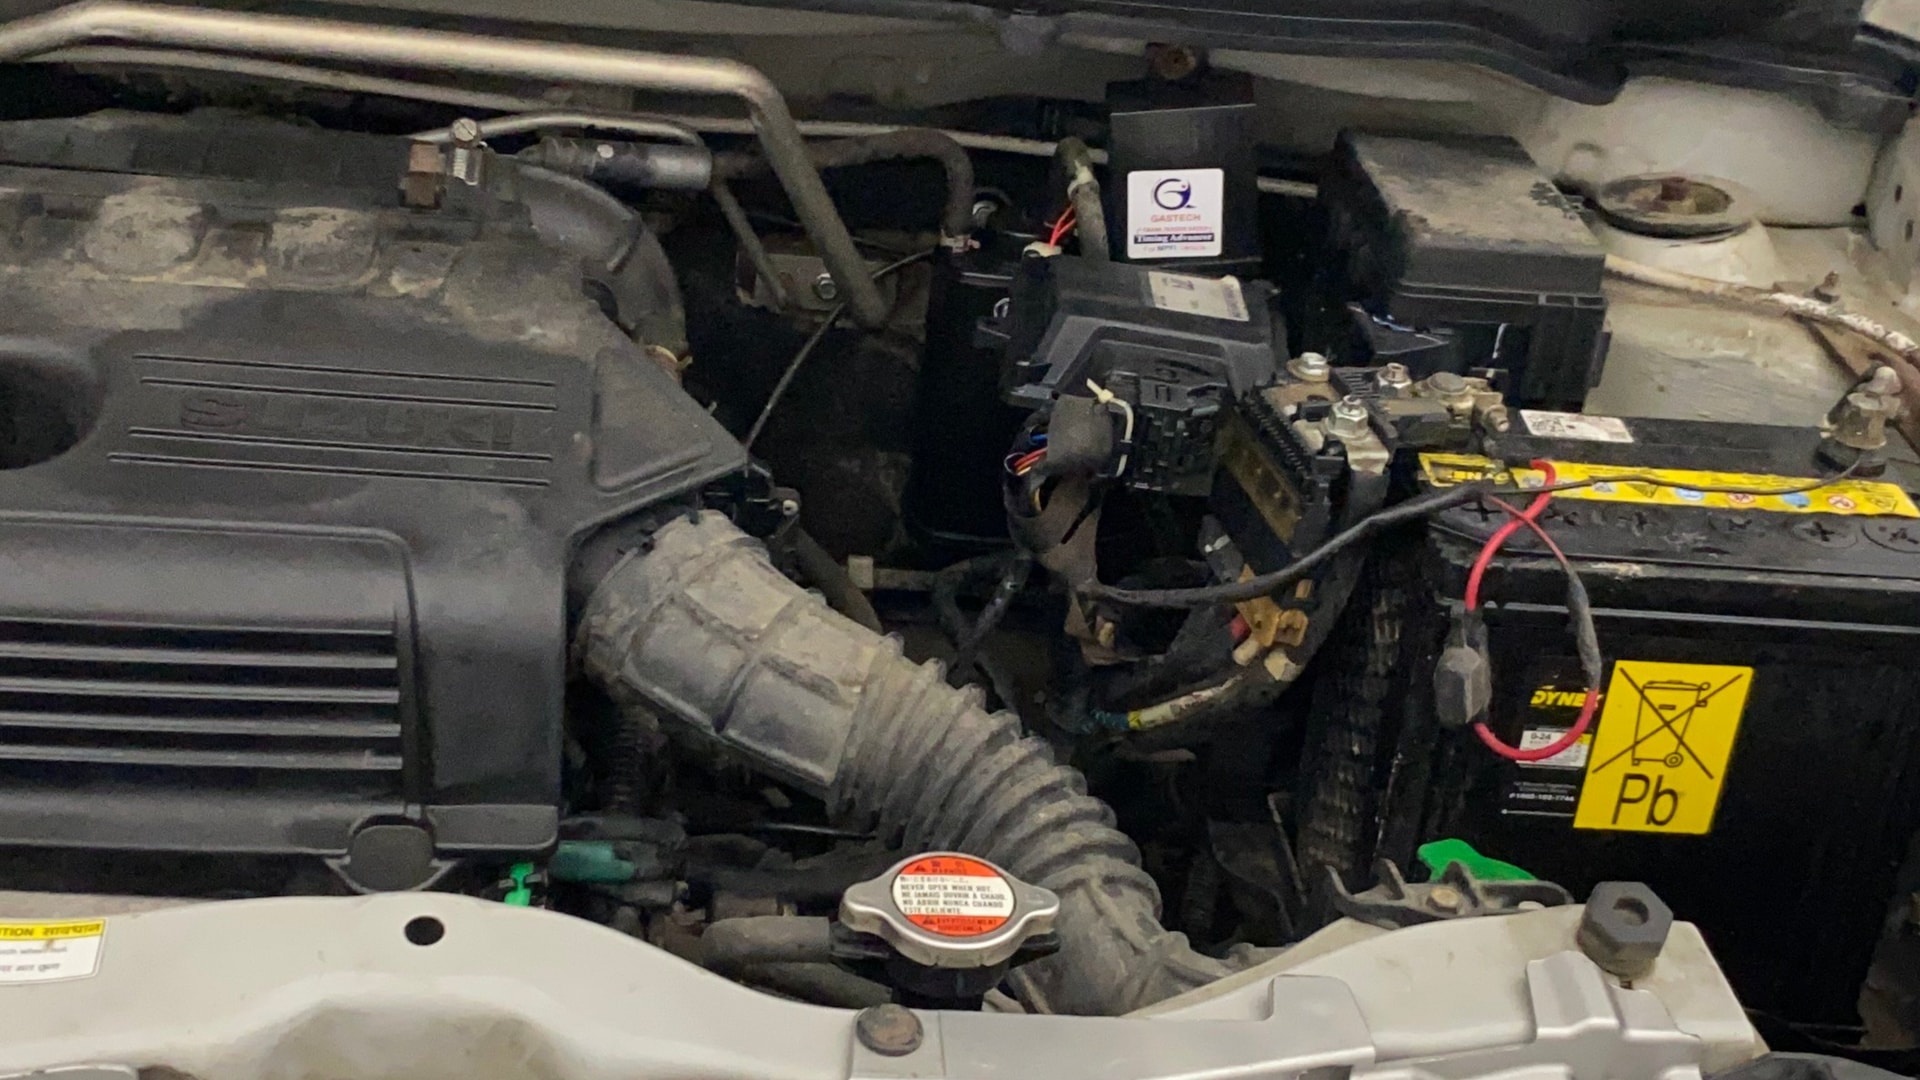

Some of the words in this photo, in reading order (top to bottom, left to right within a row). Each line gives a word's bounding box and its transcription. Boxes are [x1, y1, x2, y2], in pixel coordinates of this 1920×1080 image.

[1150, 213, 1201, 223] GASTECH
[181, 396, 514, 450] SUZUKI
[1611, 773, 1679, 826] Pb
